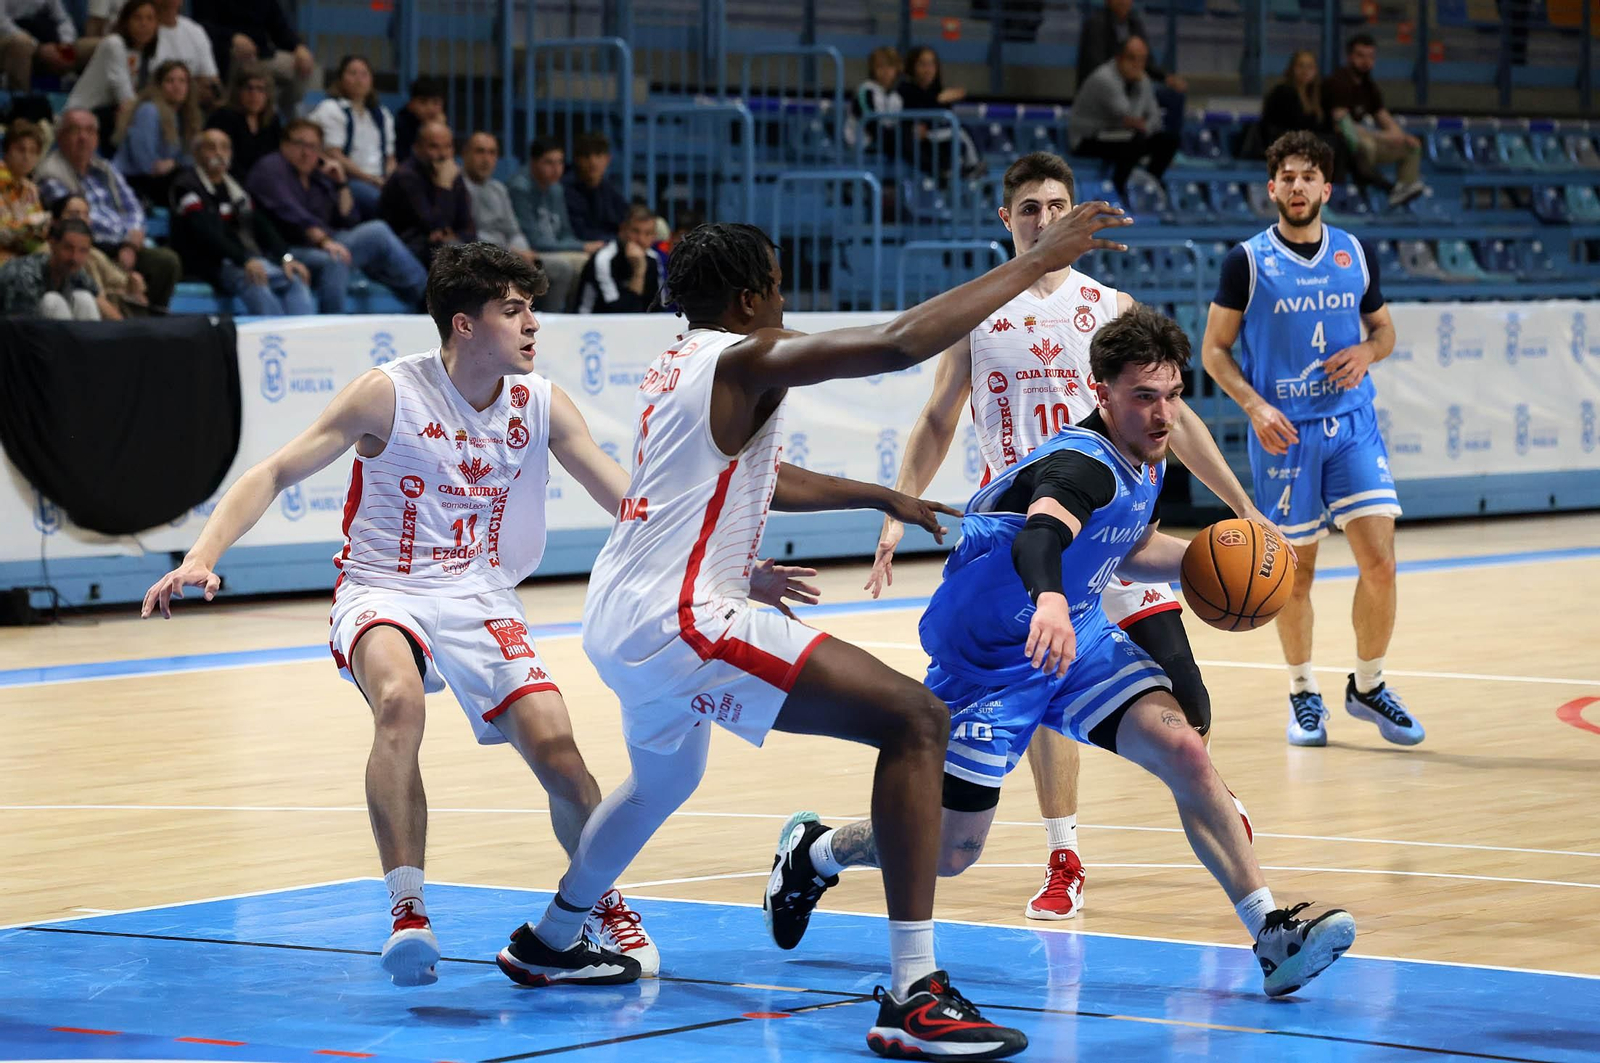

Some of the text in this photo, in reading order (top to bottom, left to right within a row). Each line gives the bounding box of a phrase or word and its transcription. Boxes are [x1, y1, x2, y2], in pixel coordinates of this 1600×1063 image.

[1311, 321, 1327, 354] 4
[1015, 368, 1079, 380] CAJA RURAL
[1034, 403, 1069, 436] 10
[438, 485, 466, 496] CAJA
[1278, 485, 1290, 516] 4
[451, 513, 477, 547] 11
[1087, 556, 1121, 595] 40
